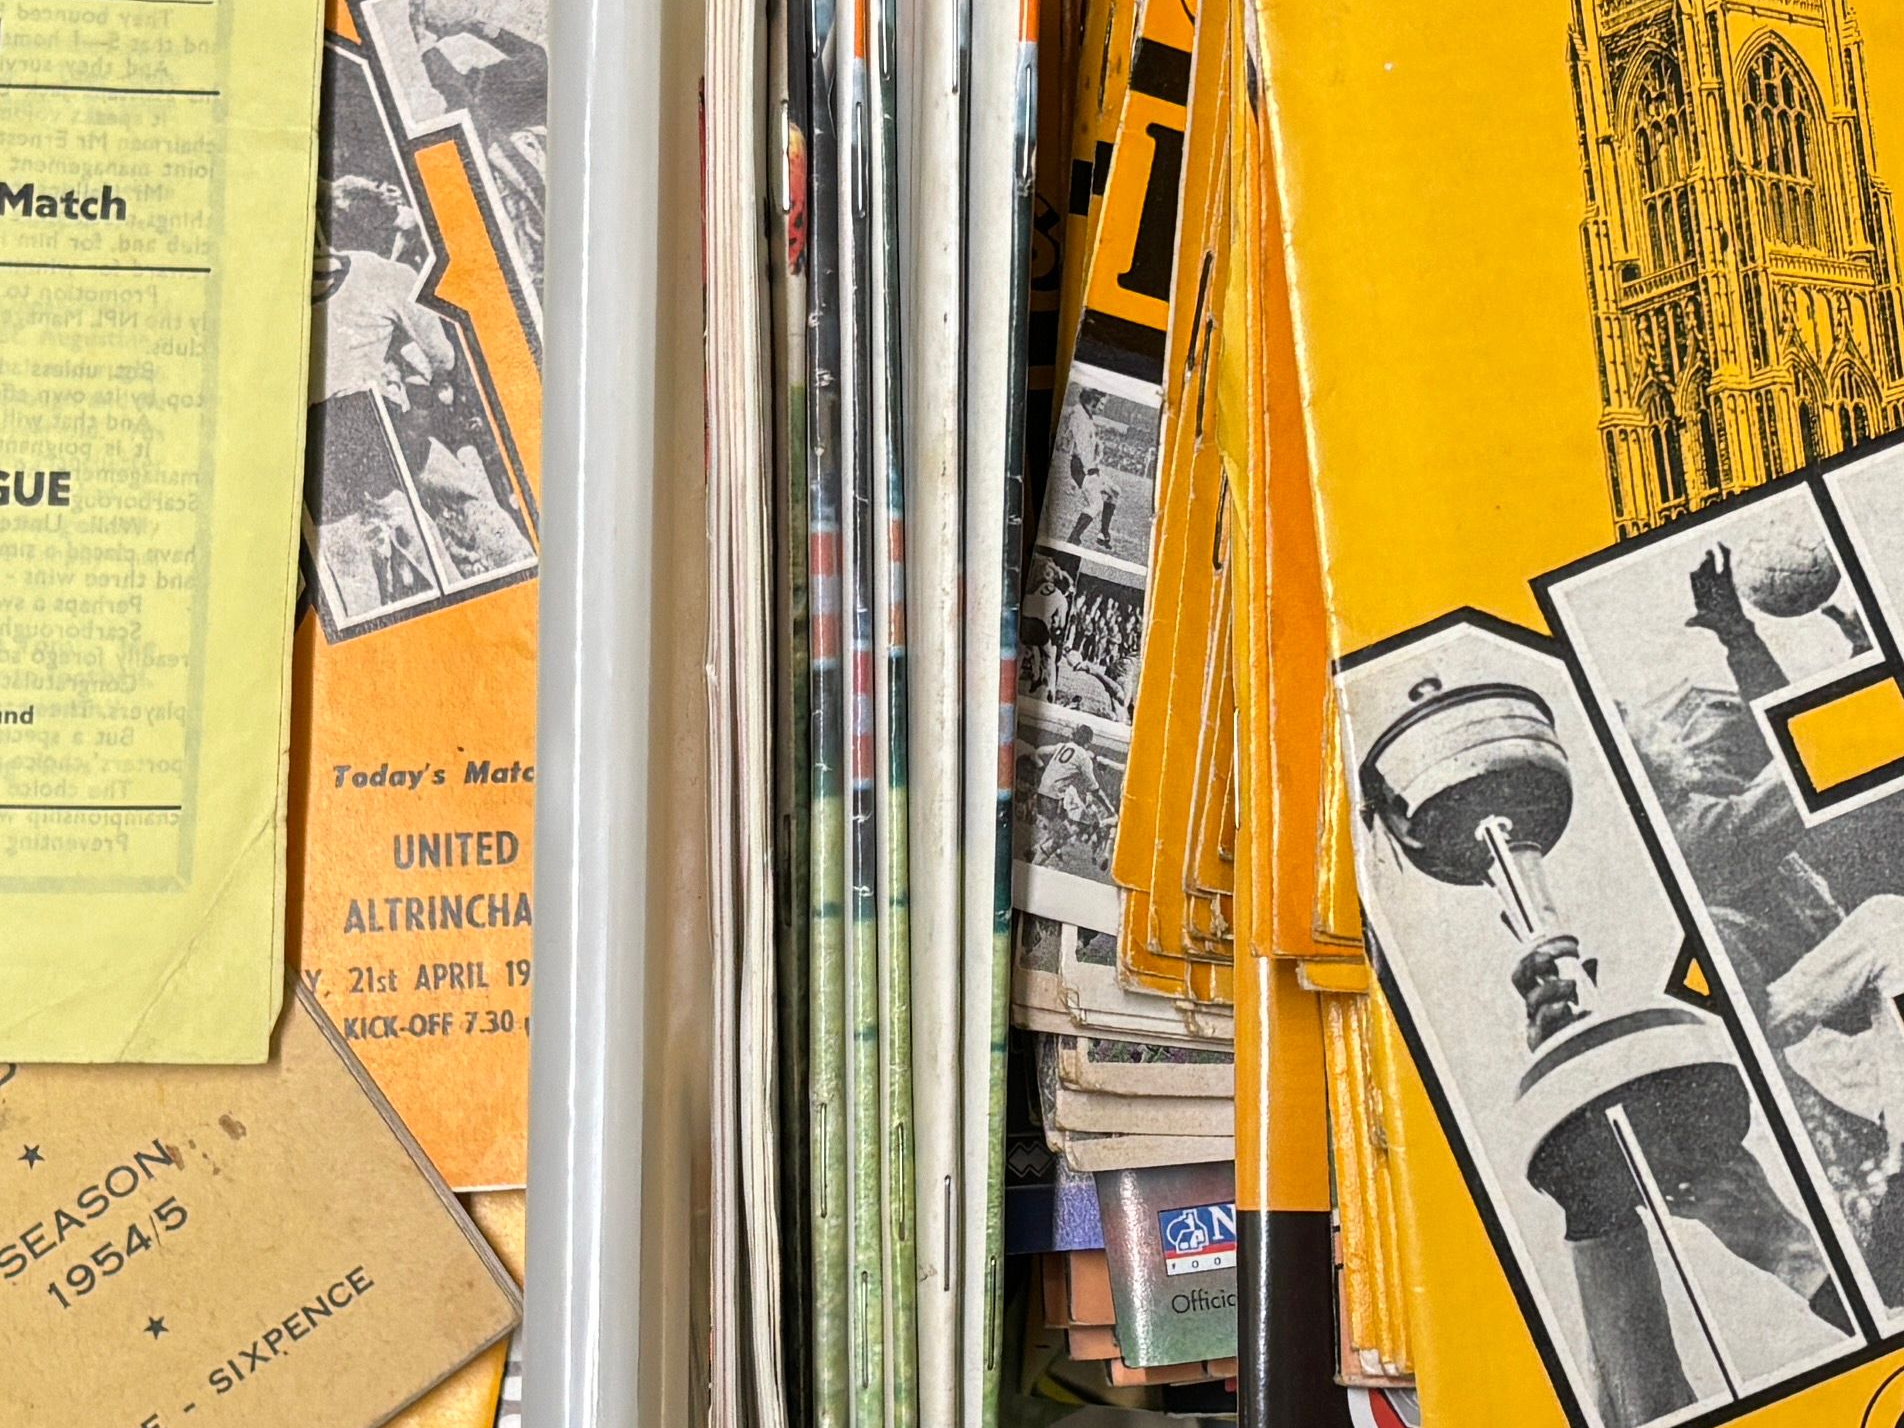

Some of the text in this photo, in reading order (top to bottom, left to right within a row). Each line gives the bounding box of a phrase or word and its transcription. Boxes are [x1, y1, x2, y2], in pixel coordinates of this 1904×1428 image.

[334, 761, 534, 790] Today's Matc
[394, 831, 518, 869] UNITED
[344, 893, 532, 933] ALTRINCHA
[349, 967, 397, 993] 21st
[415, 962, 489, 990] APRIL
[506, 959, 530, 986] 19
[343, 1012, 454, 1042] KICK-OFF
[45, 1193, 189, 1310] 1954/5
[209, 1266, 374, 1394] SIXPENCE
